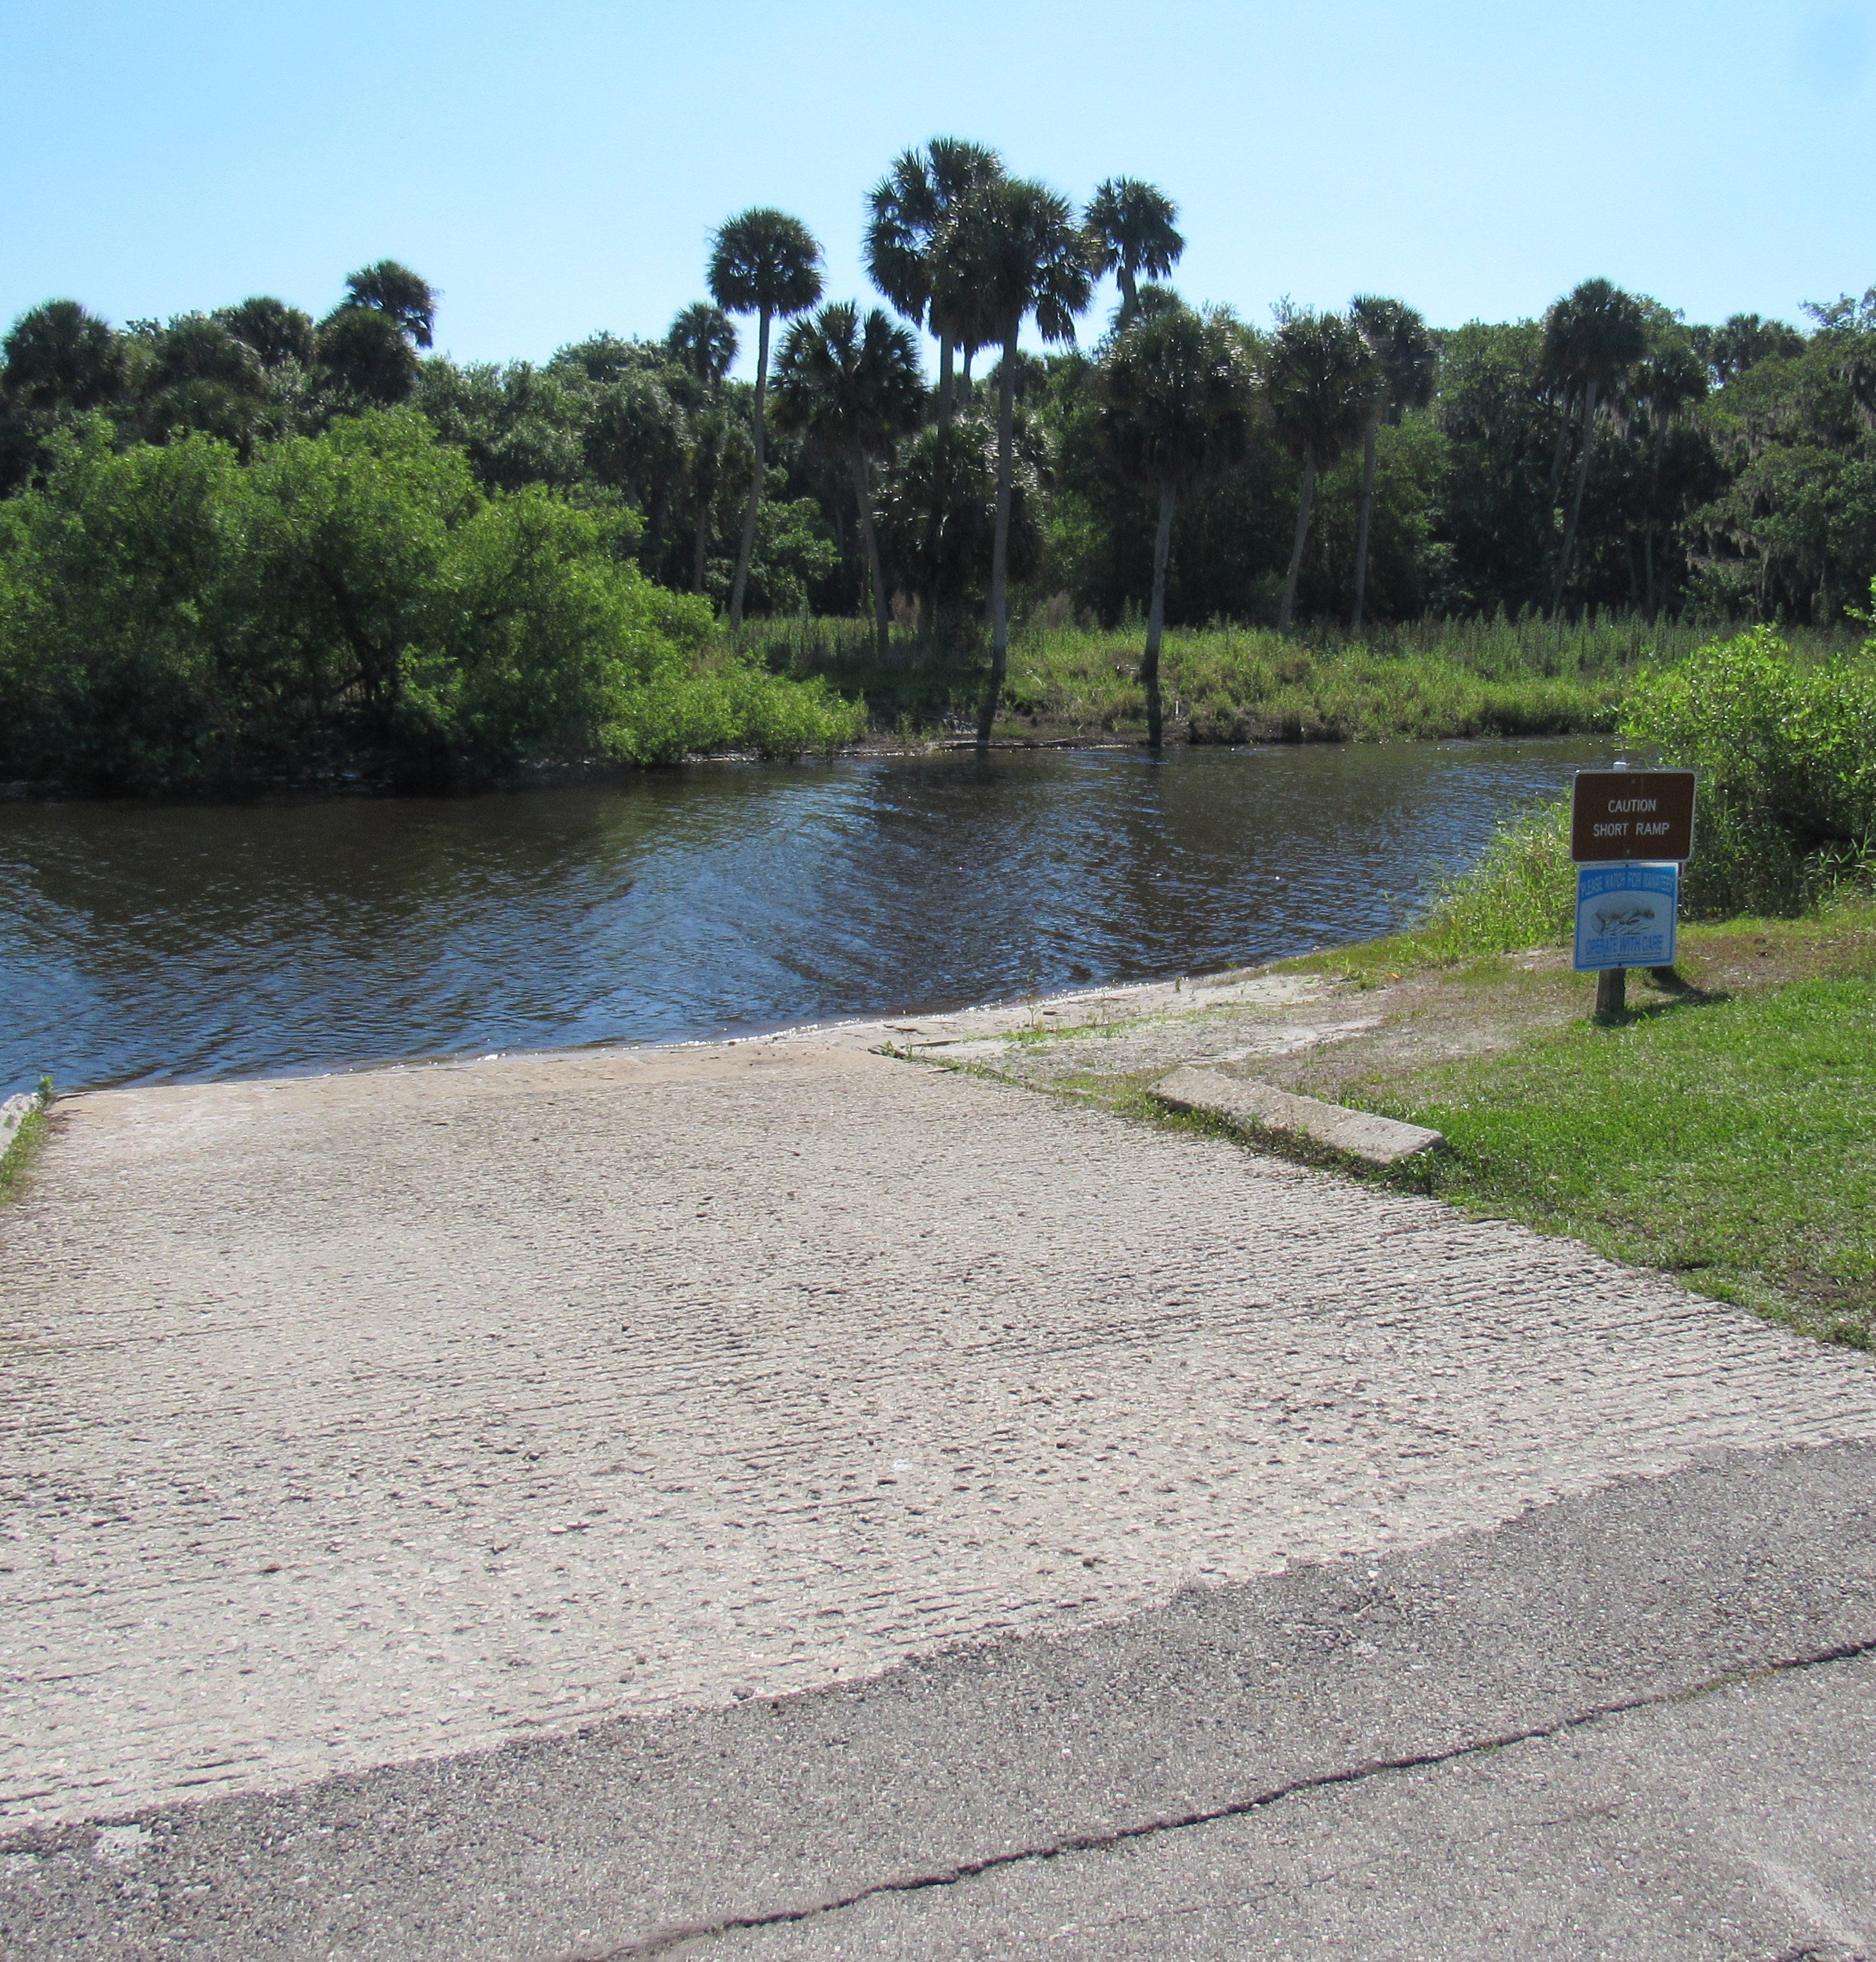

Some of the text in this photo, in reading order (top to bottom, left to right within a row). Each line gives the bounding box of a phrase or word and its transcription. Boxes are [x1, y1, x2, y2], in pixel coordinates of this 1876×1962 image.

[1608, 799, 1657, 813] CAUTION
[1593, 823, 1669, 836] SHORT RAMP
[1627, 872, 1642, 888] FOR
[1619, 936, 1640, 954] WITH
[1642, 935, 1664, 952] CARE
